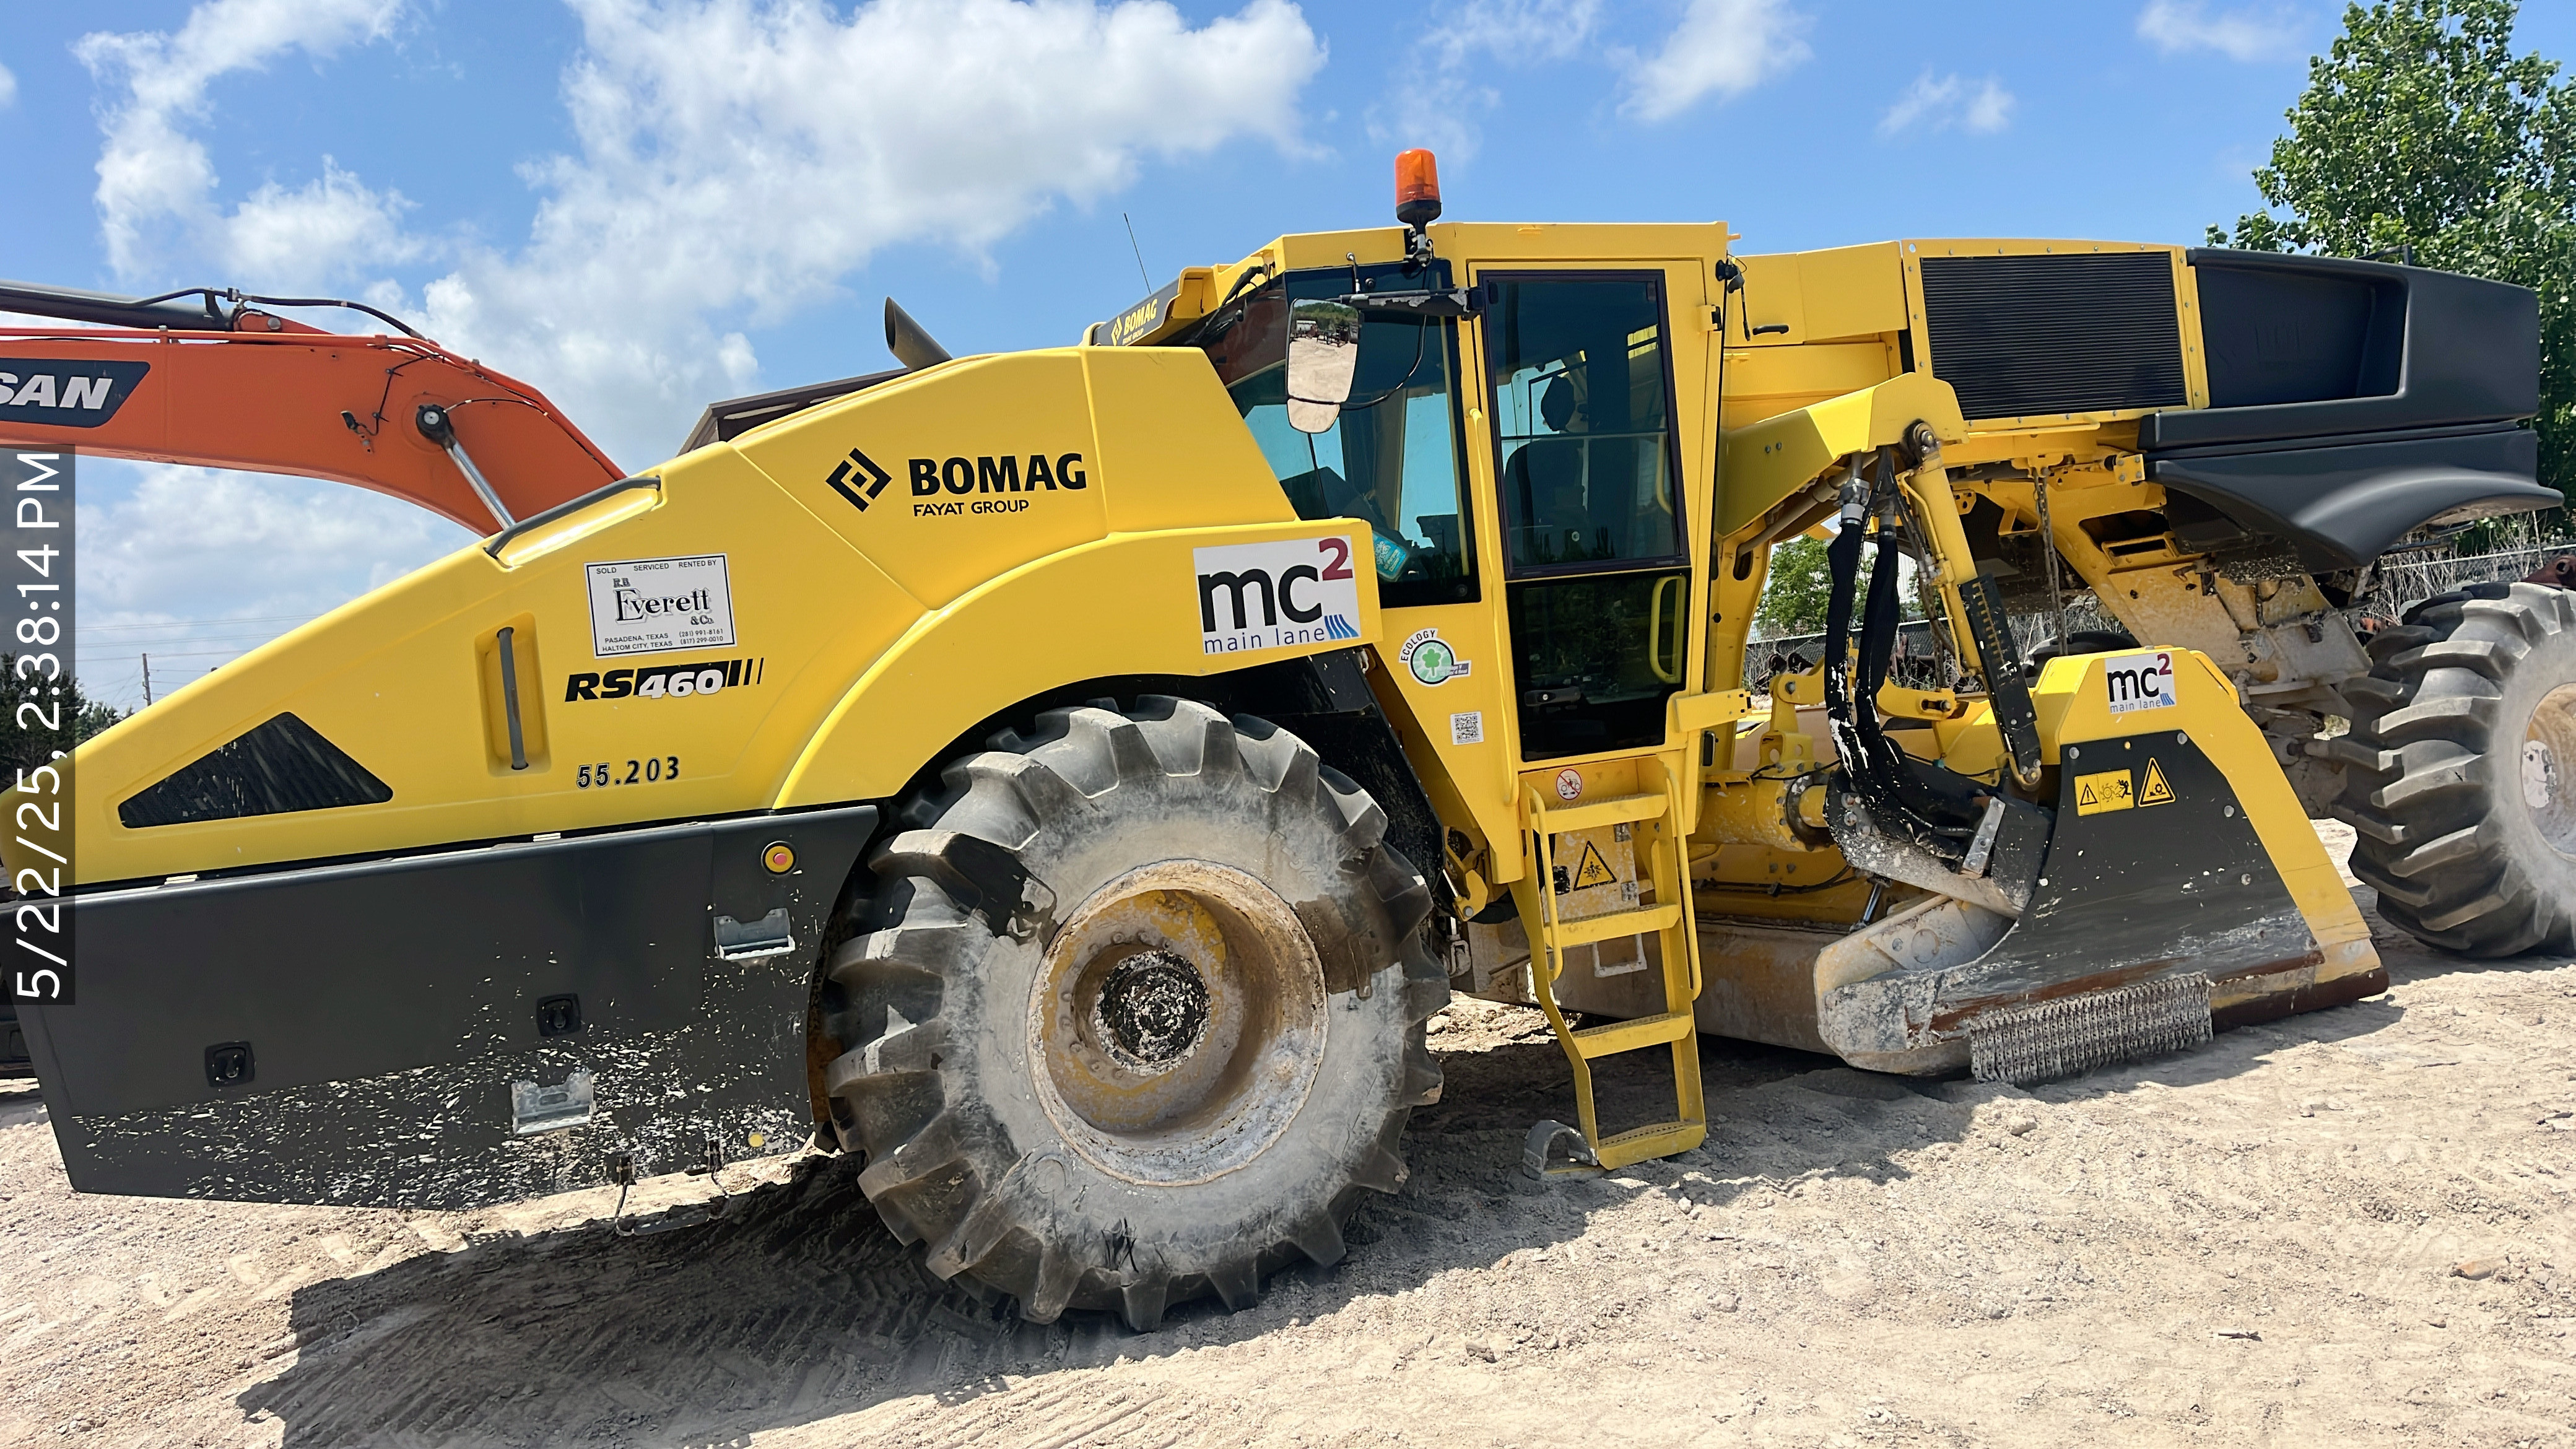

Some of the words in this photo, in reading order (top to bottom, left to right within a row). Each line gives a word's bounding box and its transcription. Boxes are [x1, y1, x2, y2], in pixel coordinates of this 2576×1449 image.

[1123, 298, 1157, 336] BOMAG
[908, 453, 1087, 496] BOMAG
[913, 502, 964, 516] FAYAT
[971, 500, 1029, 514] GROUP
[633, 563, 669, 572] SERVICED
[614, 588, 711, 624] Everett
[605, 635, 644, 643] PASADENA,
[679, 630, 694, 638] (281)
[695, 629, 723, 637] 991-8161
[680, 637, 695, 646] (817)
[1204, 632, 1262, 653] main
[1276, 627, 1325, 645] lane
[603, 643, 630, 652] HALTOM
[632, 642, 649, 650] CITY,
[1401, 630, 1435, 661] ECOLOGY
[2110, 703, 2135, 713] main
[2139, 700, 2161, 709] lane
[577, 755, 680, 790] 55.203
